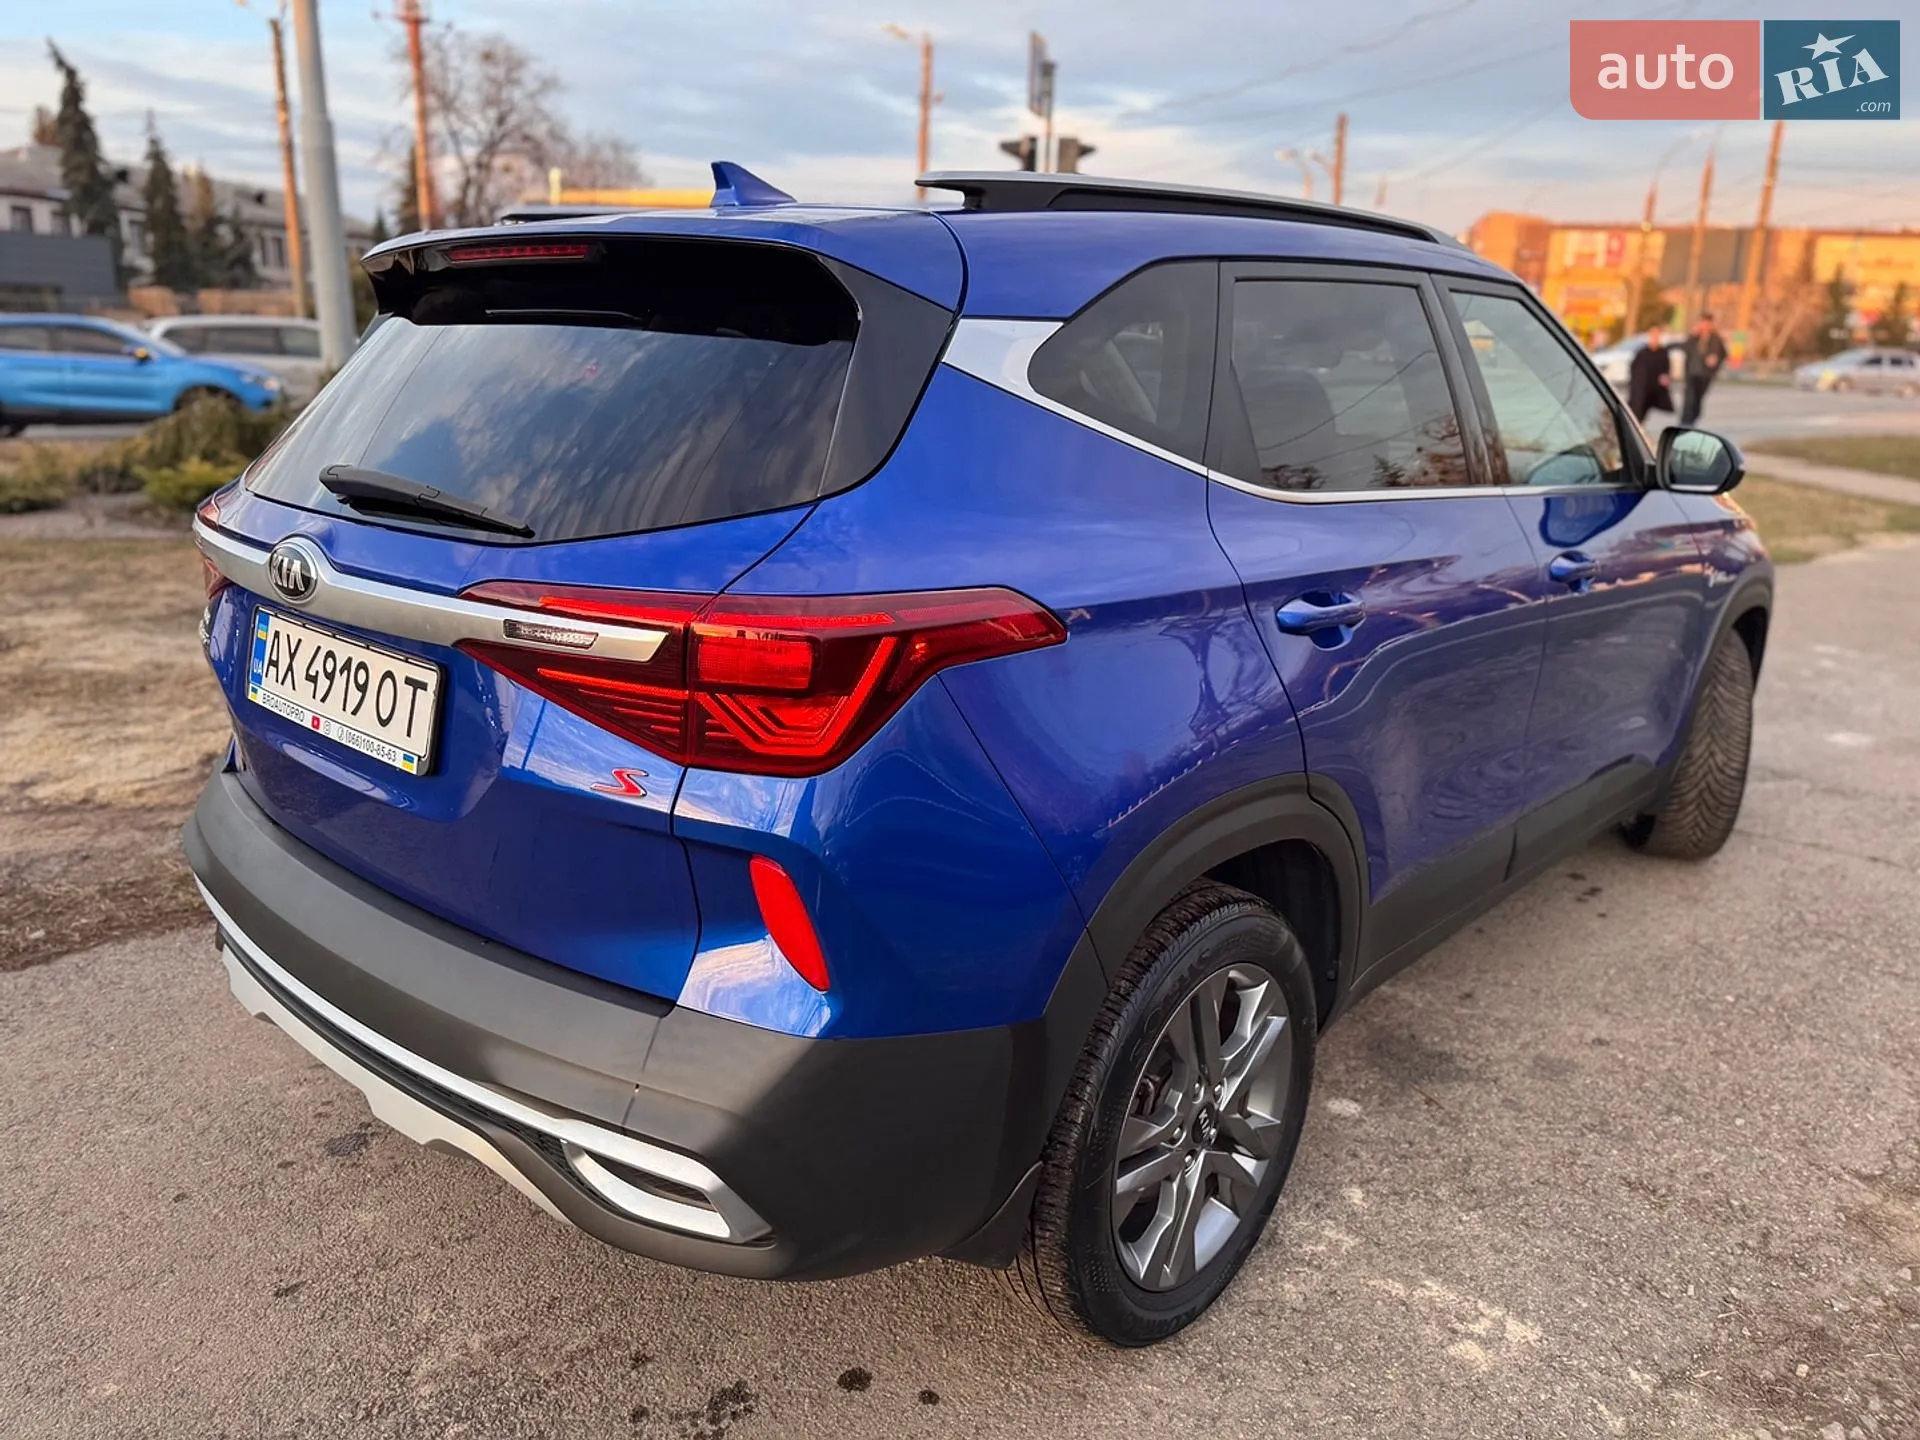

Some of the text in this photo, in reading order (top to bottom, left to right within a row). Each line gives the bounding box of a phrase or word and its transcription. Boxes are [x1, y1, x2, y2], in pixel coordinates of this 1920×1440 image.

[272, 555, 304, 592] KIA
[264, 630, 428, 738] AX 4919 OT
[261, 693, 306, 723] BROAUTOPRO
[590, 768, 648, 798] S
